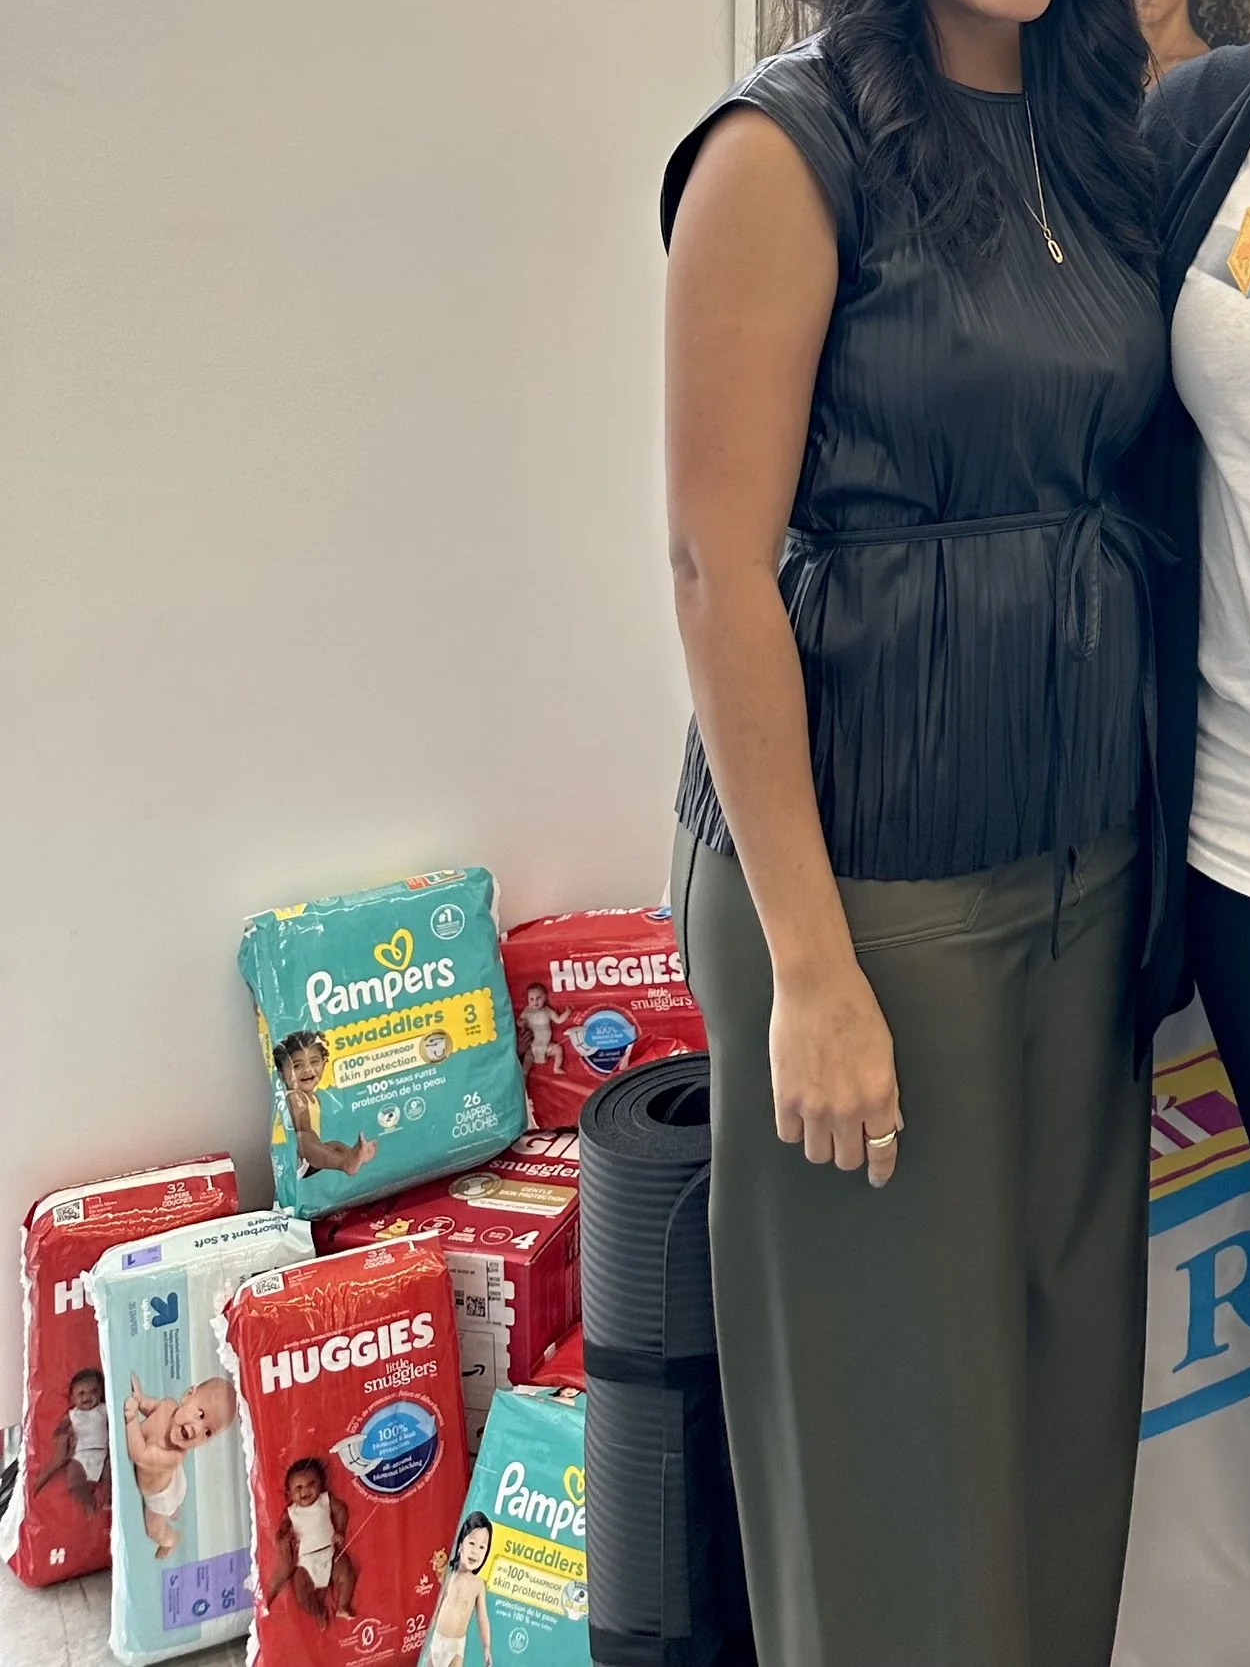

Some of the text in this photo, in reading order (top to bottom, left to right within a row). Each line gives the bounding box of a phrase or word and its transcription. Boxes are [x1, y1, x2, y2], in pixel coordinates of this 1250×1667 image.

[550, 951, 686, 993] HUGGIES
[306, 957, 455, 1023] Pampers
[463, 1004, 478, 1024] 3
[630, 994, 694, 1012] snugglers
[334, 1009, 444, 1051] swaddlers
[343, 1043, 415, 1071] 100% LEAKPROOF
[339, 1055, 417, 1084] skin protection
[351, 1076, 447, 1112] protection de la peau
[366, 1079, 395, 1096] 100%
[395, 1074, 414, 1086] SANS
[463, 1091, 481, 1109] 26
[455, 1102, 493, 1125] DIAPERS
[452, 1114, 499, 1139] COUCHES
[489, 1159, 580, 1178] snuggler
[166, 1181, 185, 1193] 32
[204, 1176, 215, 1192] 1
[194, 1222, 289, 1248] Absorbent & Soft
[510, 1230, 540, 1250] 4
[260, 1312, 435, 1395] HUGGIES
[363, 1360, 438, 1394] snugglers
[385, 1358, 410, 1375] little
[378, 1422, 409, 1442] 100%
[494, 1461, 587, 1542] Pampe
[504, 1539, 585, 1577] swaddlers
[507, 1565, 530, 1581] 100%
[221, 1586, 235, 1609] 35
[493, 1577, 560, 1606] skin protection
[406, 1614, 427, 1634] 32
[401, 1640, 424, 1654] COUC
[403, 1630, 425, 1646] DIAPE
